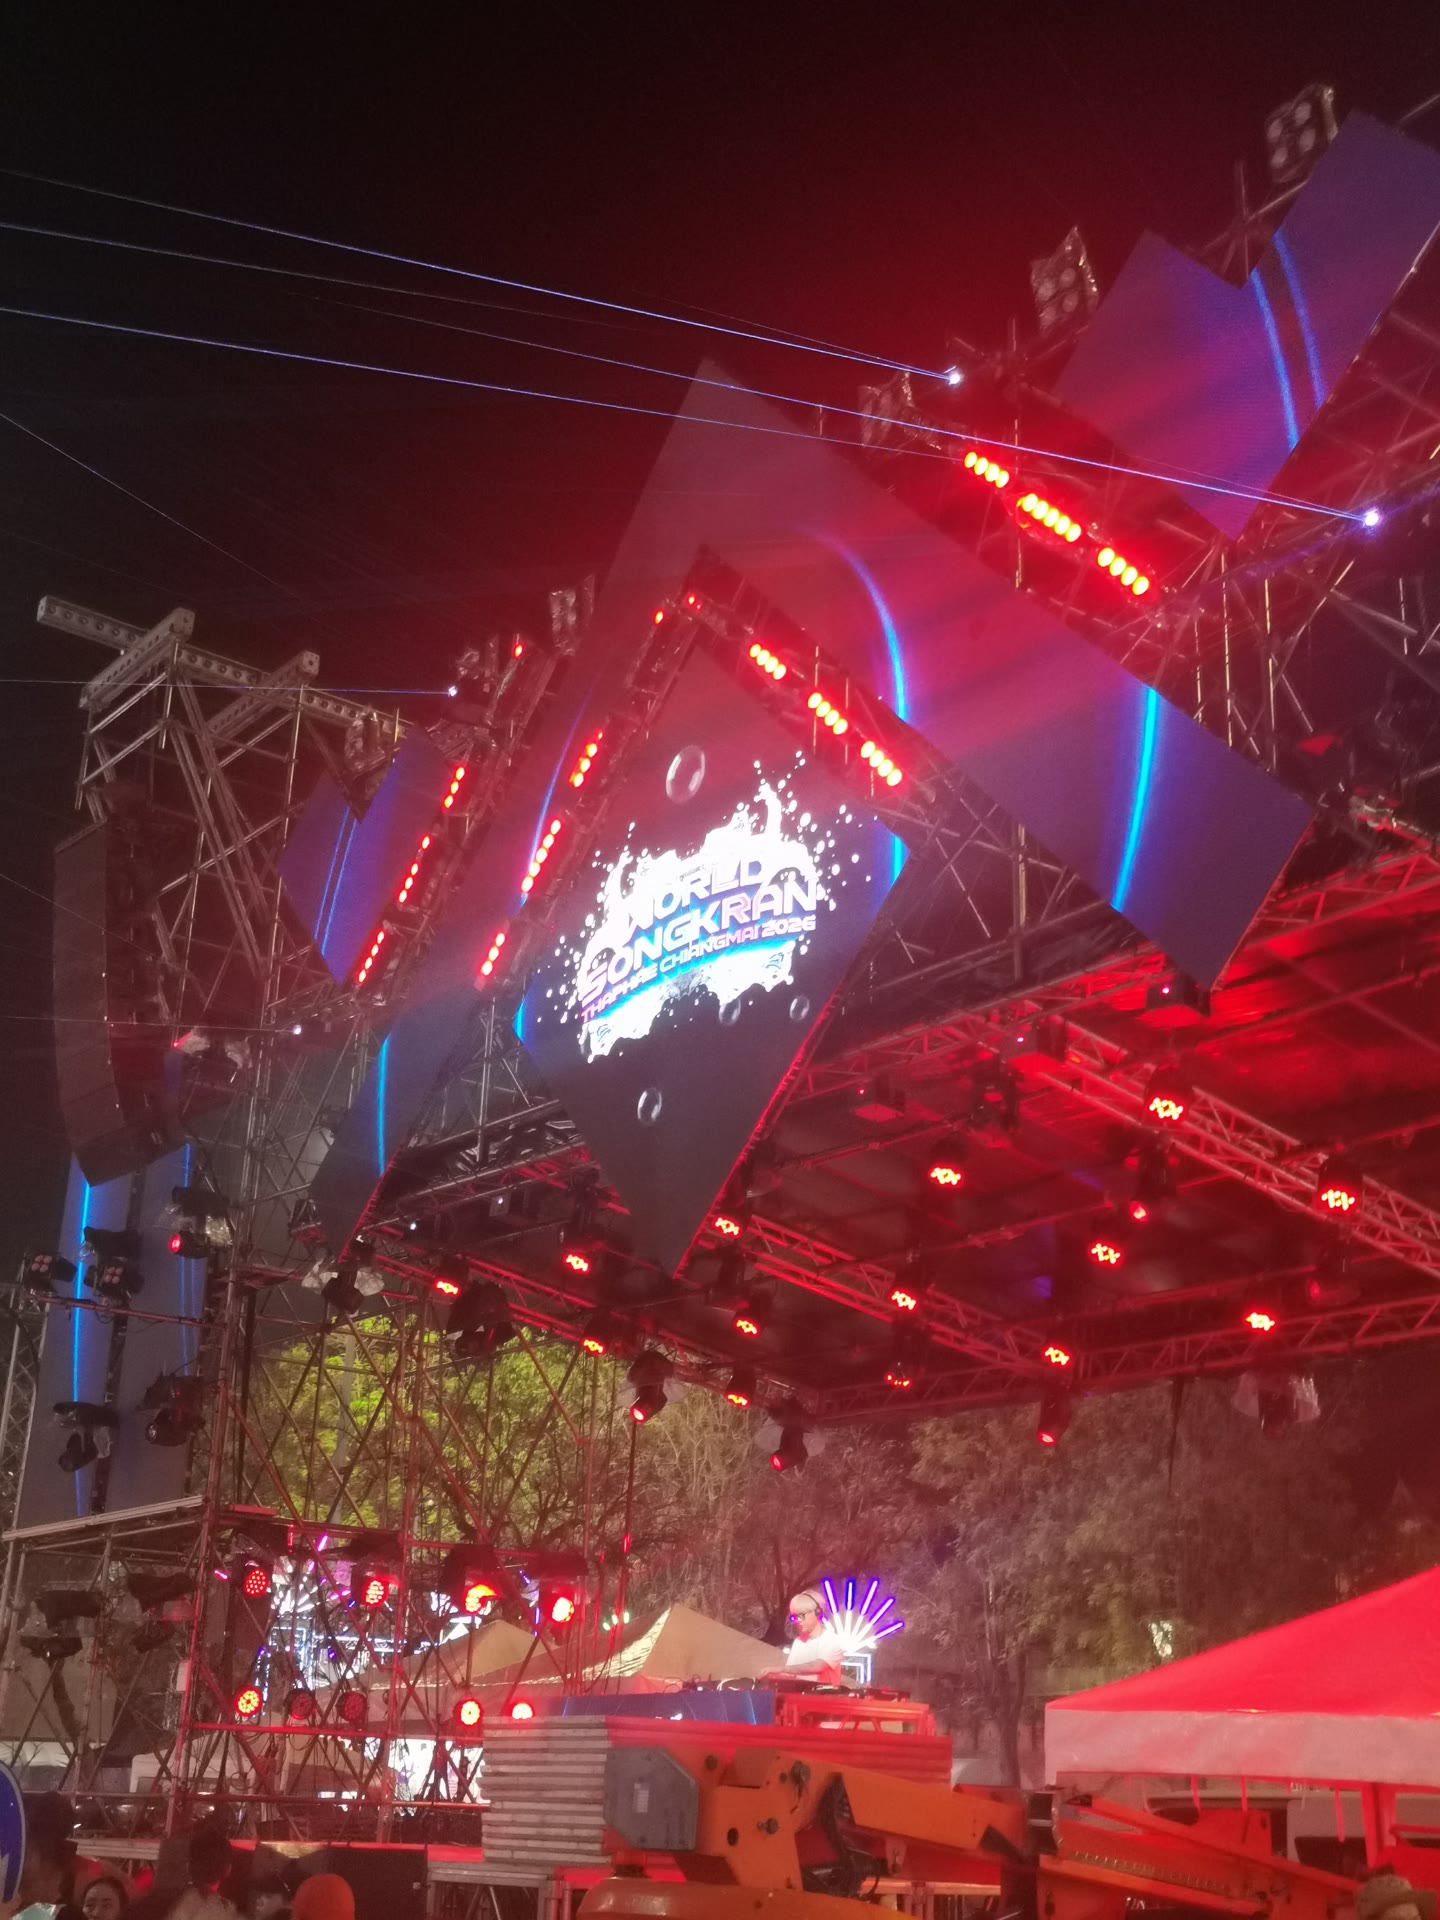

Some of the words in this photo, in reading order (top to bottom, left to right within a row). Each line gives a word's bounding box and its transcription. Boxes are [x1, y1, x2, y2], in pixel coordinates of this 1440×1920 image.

[619, 858, 769, 941] WORLD
[580, 877, 816, 1008] SONGKRAN
[660, 926, 759, 974] CHIANGMAI
[761, 915, 816, 938] 2026
